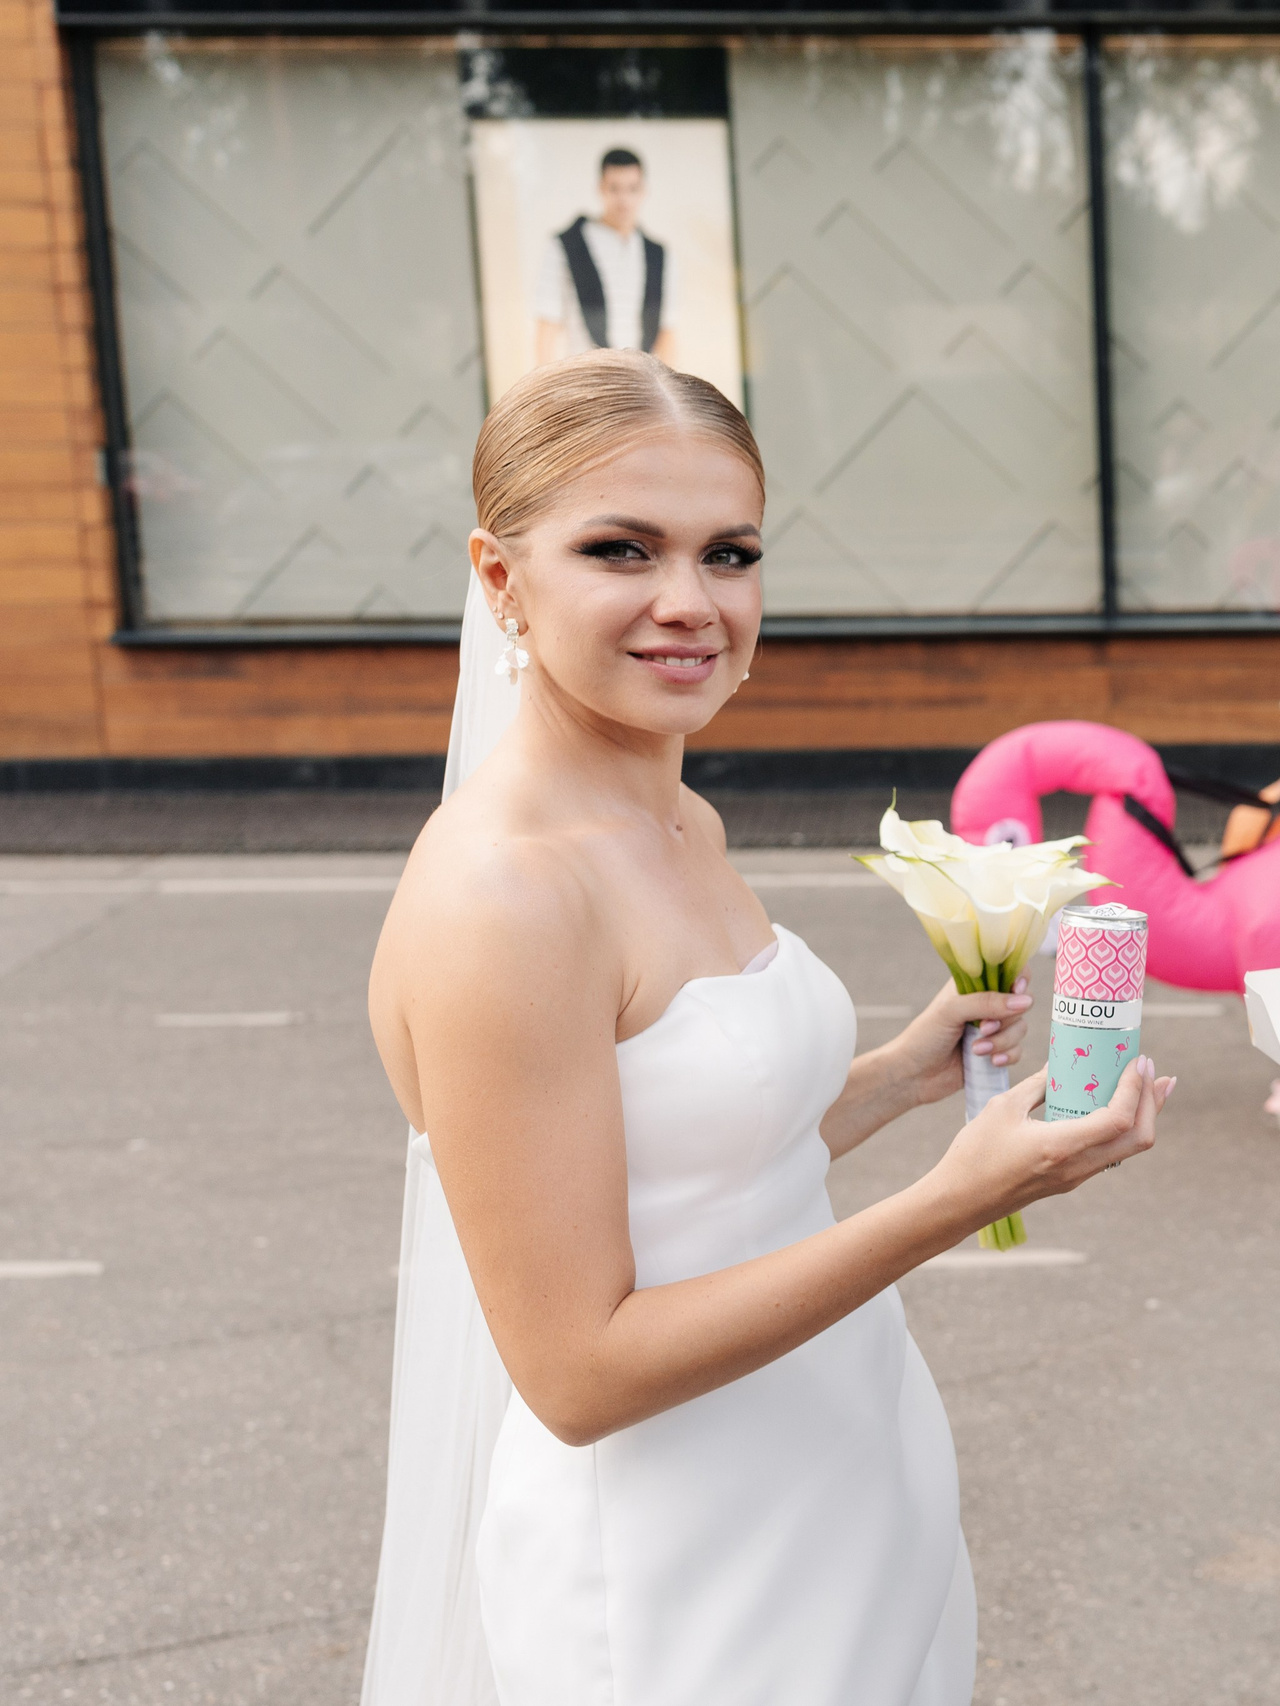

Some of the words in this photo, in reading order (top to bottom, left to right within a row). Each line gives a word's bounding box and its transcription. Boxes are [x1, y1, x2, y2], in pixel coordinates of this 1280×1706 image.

[1055, 999, 1077, 1015] LOU
[1081, 1004, 1115, 1018] LOU
[1058, 1015, 1086, 1024] SPARKLING
